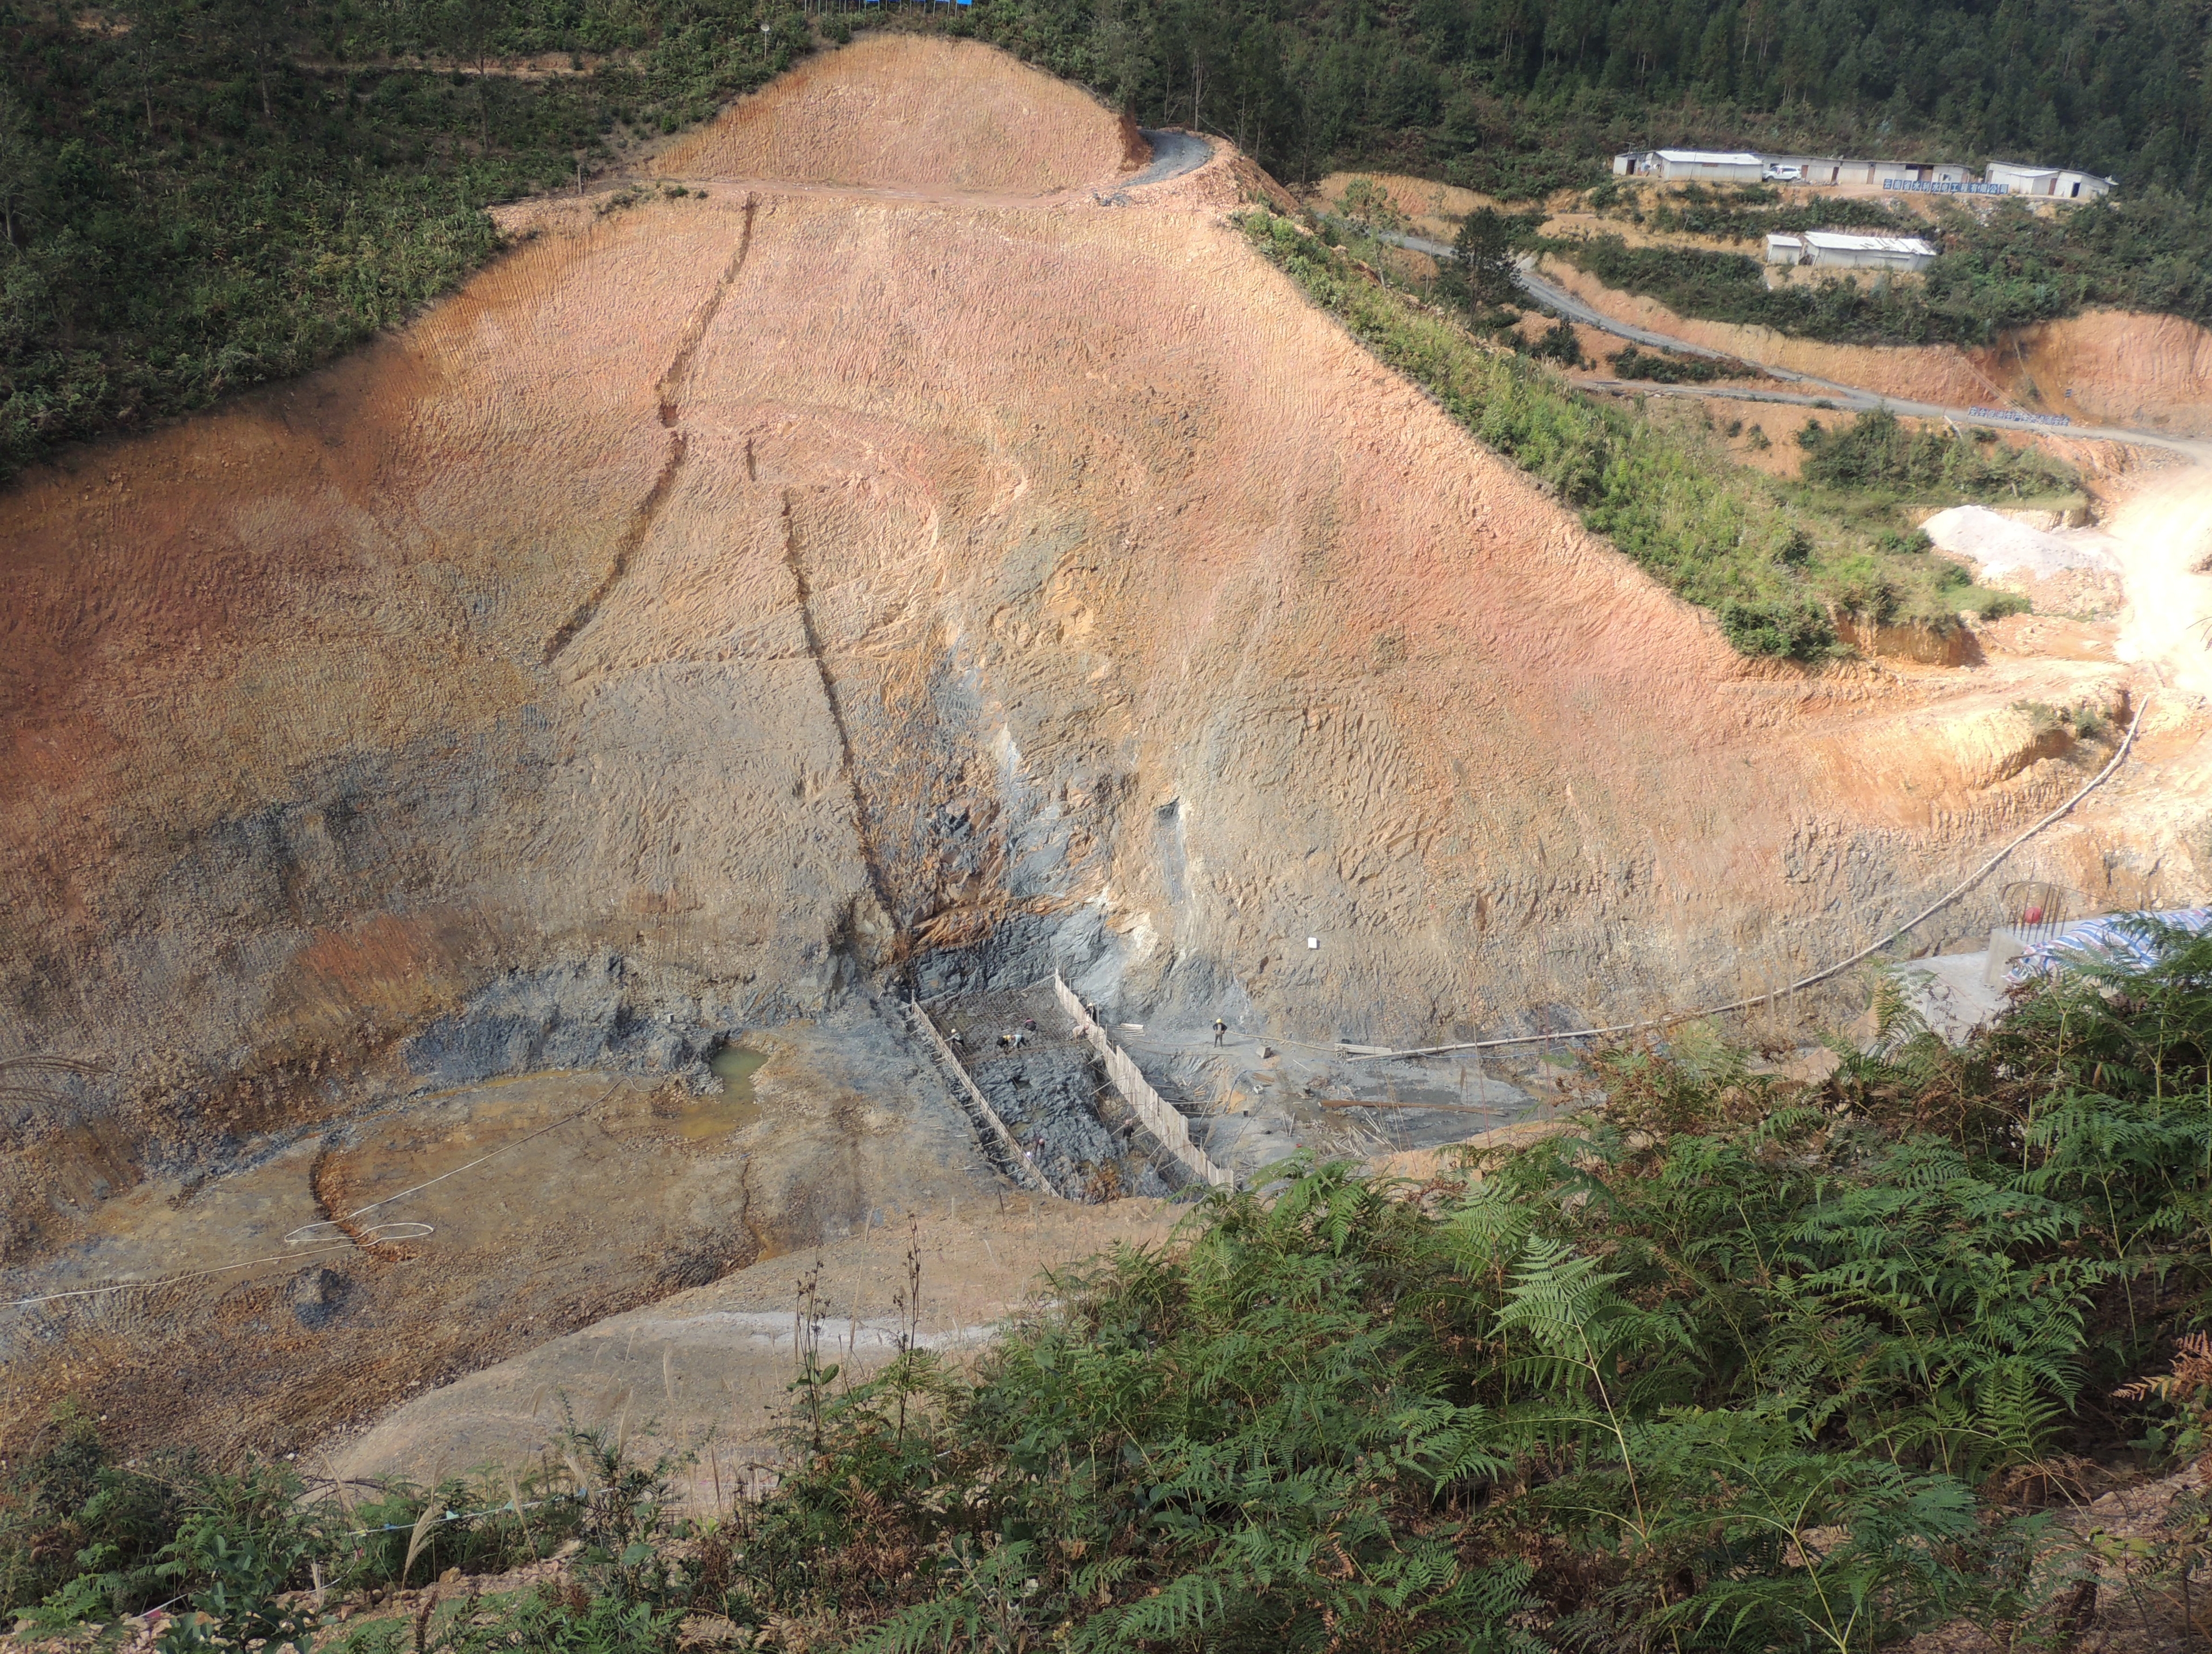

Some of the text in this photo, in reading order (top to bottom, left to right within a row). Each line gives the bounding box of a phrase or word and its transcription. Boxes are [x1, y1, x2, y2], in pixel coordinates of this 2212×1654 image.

[1884, 179, 2008, 194] 云南省水利水电工程有限公司
